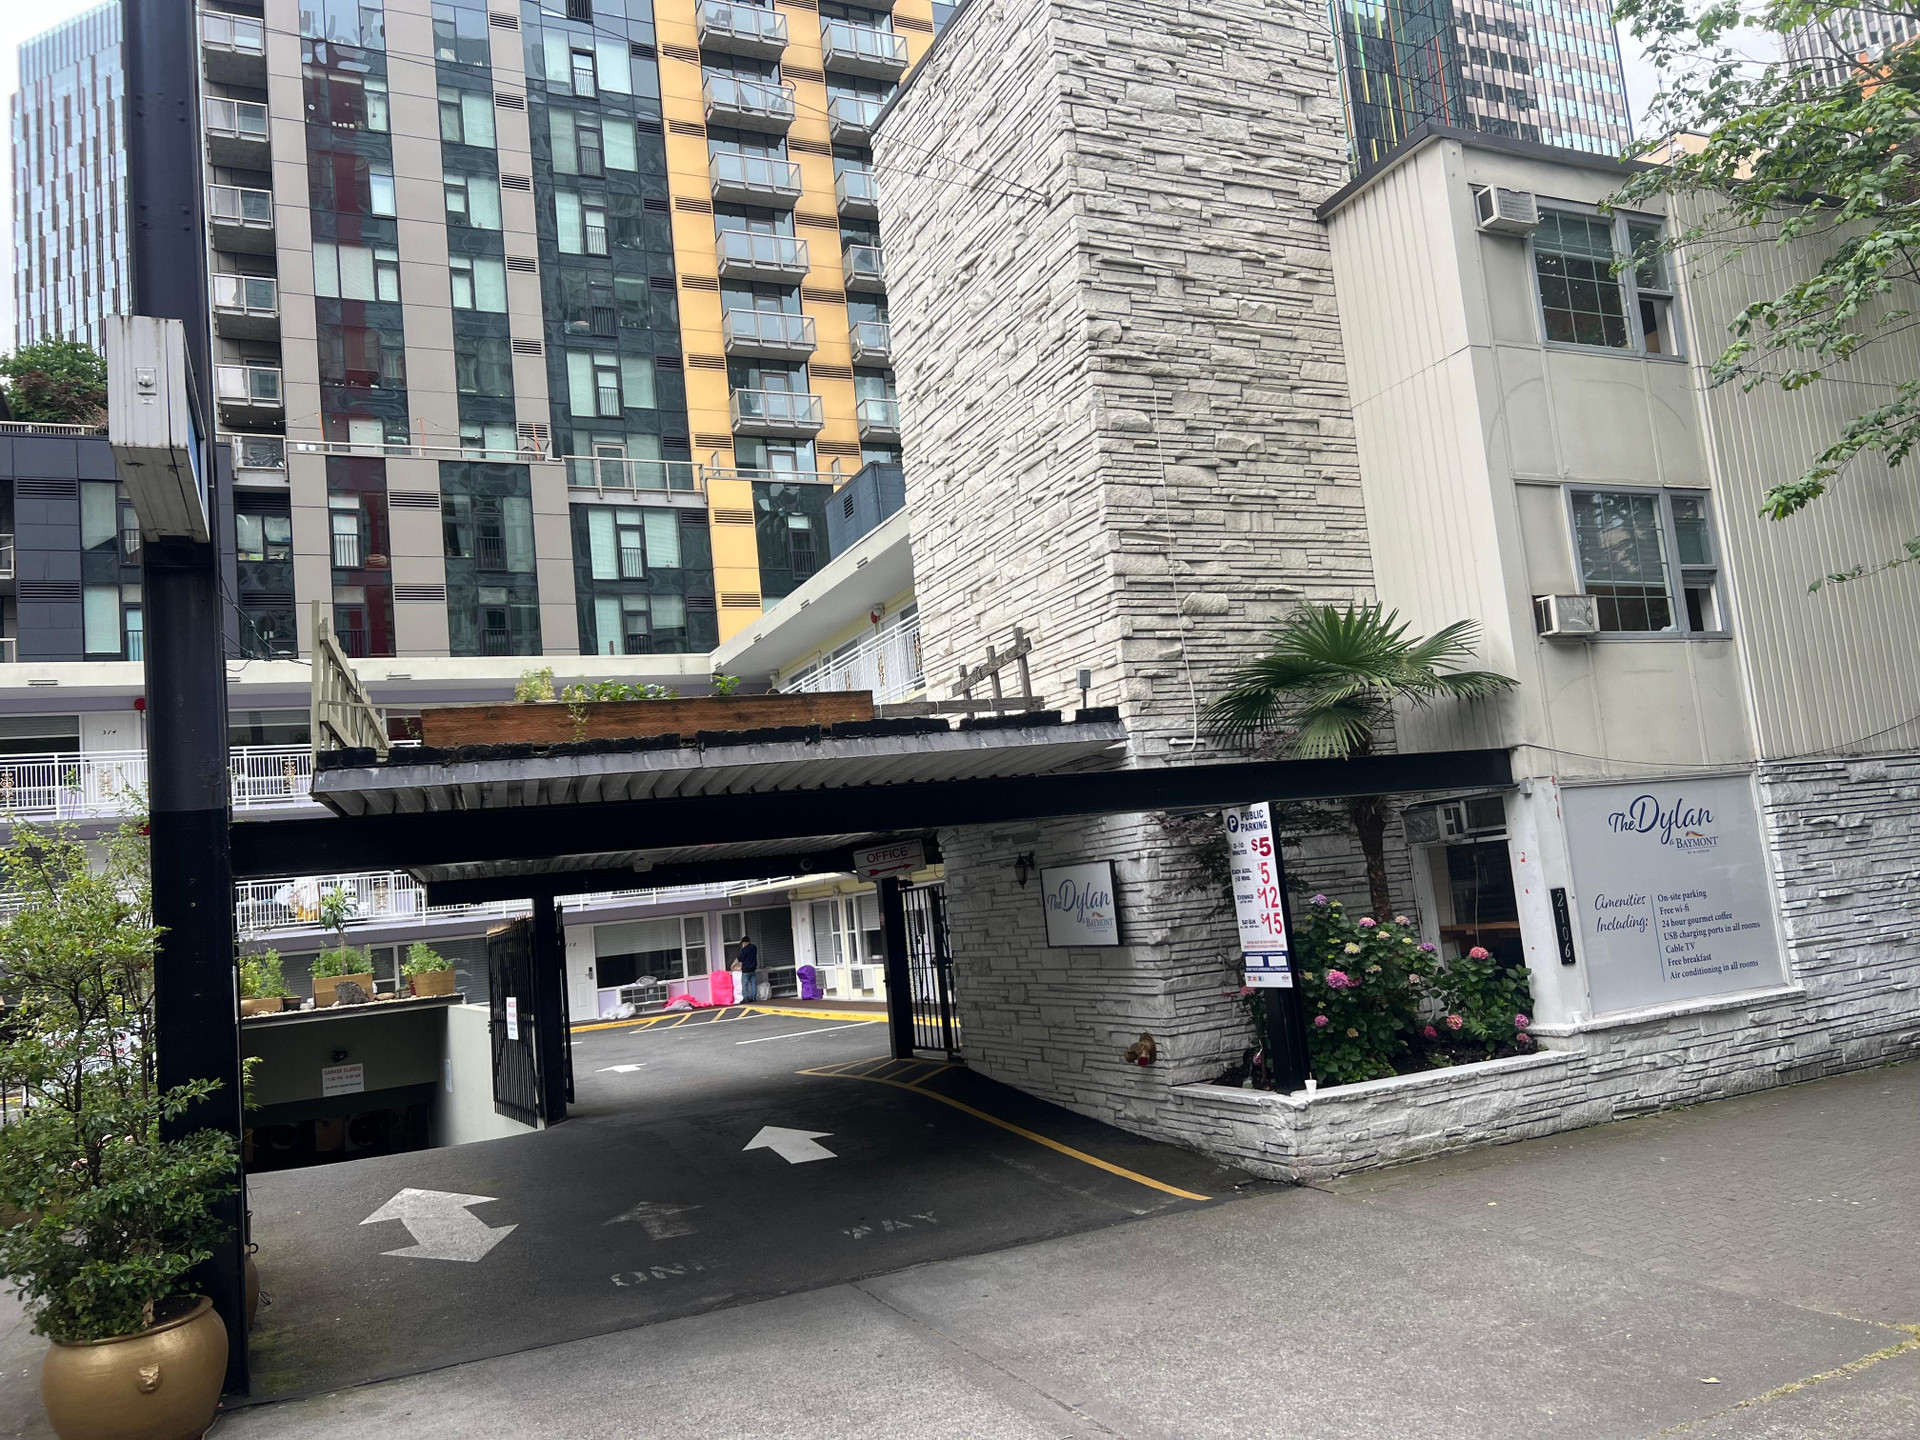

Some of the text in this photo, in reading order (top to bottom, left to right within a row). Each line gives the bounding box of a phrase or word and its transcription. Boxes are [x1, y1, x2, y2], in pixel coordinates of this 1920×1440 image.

[1240, 809, 1264, 821] PUBLIC
[1608, 794, 1715, 845] The Dylan
[1240, 820, 1268, 832] PARKING
[1251, 836, 1272, 857] $5
[1675, 836, 1719, 848] BAYMONT
[866, 846, 908, 864] OFFICE
[1257, 861, 1270, 884] $5
[1047, 878, 1110, 923] The Dylan
[1256, 886, 1279, 909] $12
[1594, 894, 1646, 910] Amenities
[1658, 890, 1707, 902] On-site parking
[1660, 904, 1690, 915] Free wi-fi
[1260, 912, 1282, 935] $15
[1557, 892, 1571, 958] 2106
[1596, 914, 1648, 933] Including:
[1662, 911, 1733, 928] 24 hour gourmet coffee
[1663, 931, 1678, 940] USB
[1679, 928, 1707, 939] charging
[1708, 926, 1724, 937] ports
[1732, 923, 1740, 931] all
[1741, 922, 1760, 930] rooms
[1665, 942, 1695, 953] Cable TV
[1667, 953, 1712, 966] Free breakfast
[1670, 960, 1759, 979] Air conditioning in all rooms
